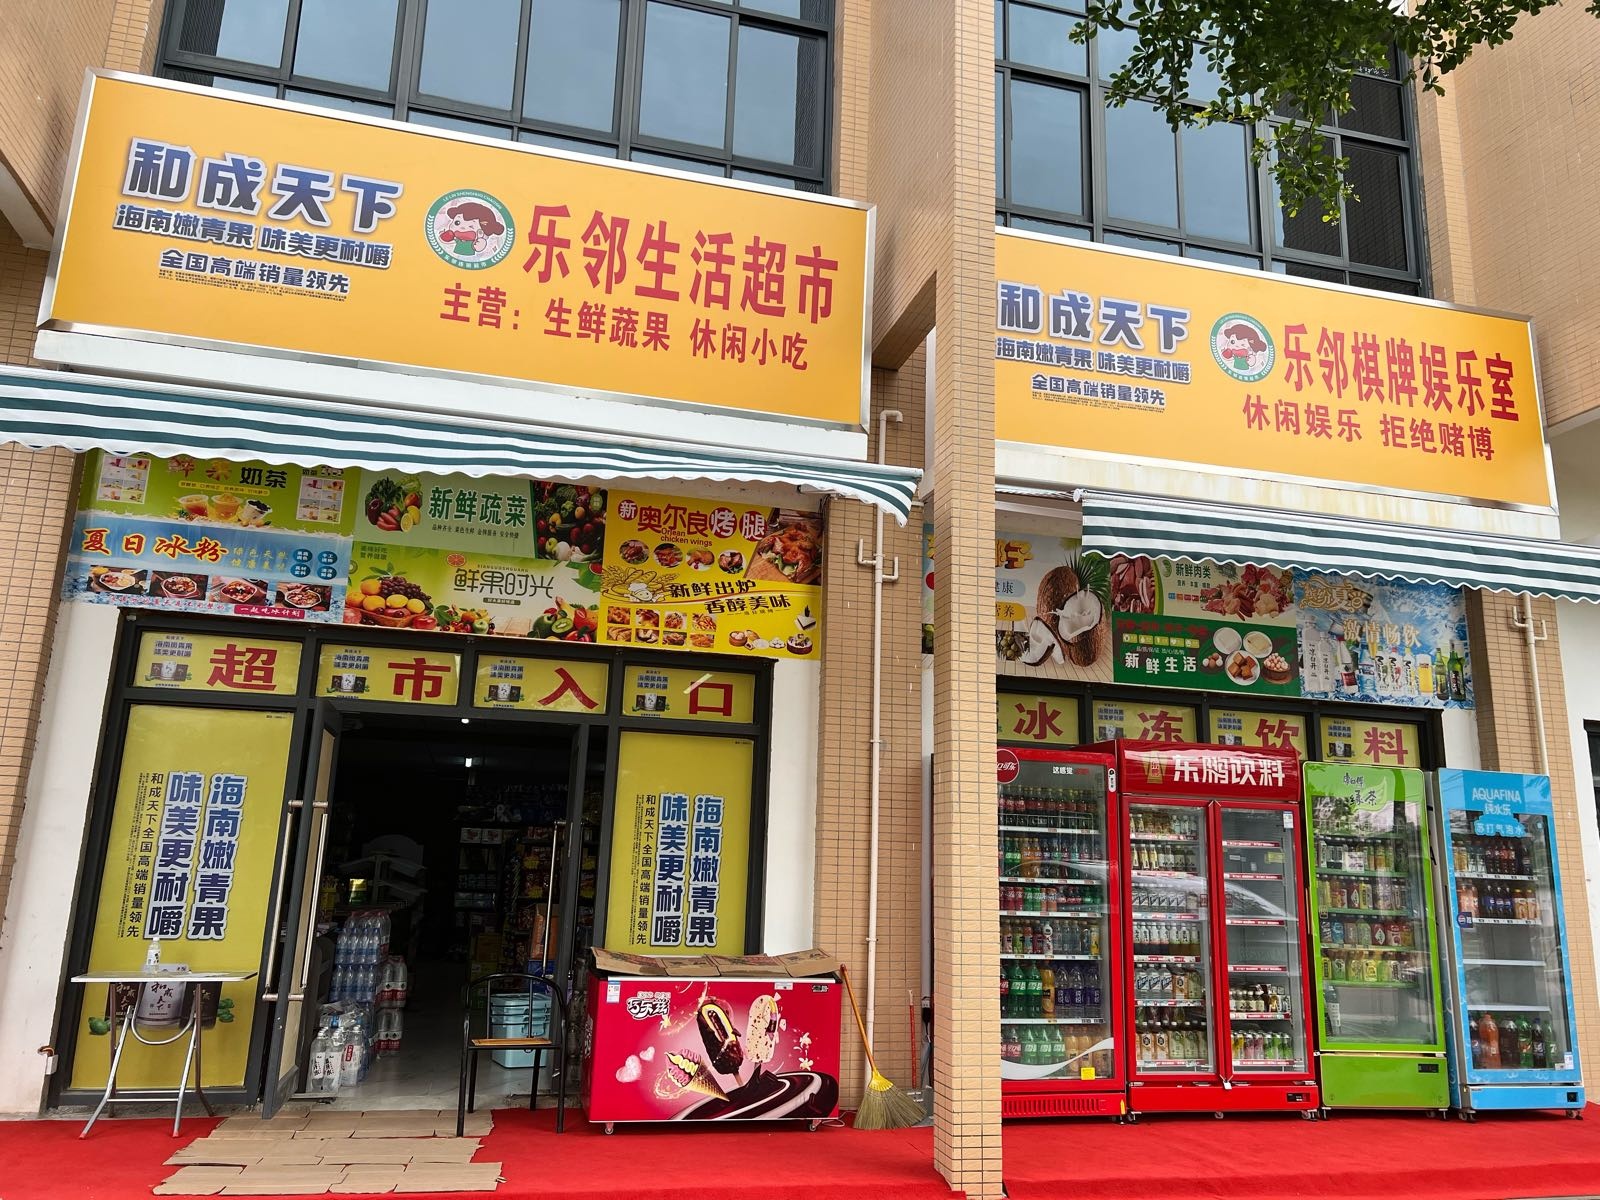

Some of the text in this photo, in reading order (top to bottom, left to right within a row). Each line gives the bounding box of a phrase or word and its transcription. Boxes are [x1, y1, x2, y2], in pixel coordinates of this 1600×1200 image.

[124, 137, 403, 233] 和成天下
[113, 205, 393, 269] 海南嫩青果 味美更耐嚼
[159, 249, 350, 294] 全国高端销量领先
[523, 205, 839, 325] 乐邻生活超市
[544, 297, 671, 352] 生鲜蔬果
[690, 318, 808, 371] 休闲小吃
[996, 280, 1192, 353] 和成天下
[995, 337, 1192, 384] 海南嫩青果 味美更耐嚼
[1282, 324, 1520, 422] 乐邻棋牌娱乐室
[1031, 373, 1166, 406] 全国高端销量领先
[1243, 394, 1495, 462] 休闲娱乐 拒绝赌博
[82, 527, 229, 563] 夏日冰粉
[660, 535, 713, 548] chicken wings
[453, 567, 555, 599] 鲜果时光
[668, 579, 757, 599] 新鲜出炉
[1175, 562, 1211, 579] 新鲜肉类
[704, 593, 792, 615] 香醇美味
[1343, 618, 1422, 648] 激情畅饮
[206, 643, 733, 717] 超 市 入 口
[1124, 652, 1197, 675] 新鲜生活
[1013, 701, 1064, 739] 冰
[1137, 710, 1185, 743] 冻
[1255, 718, 1302, 755] 饮
[1363, 726, 1408, 766] 料
[996, 761, 1017, 772] 口可乐
[1173, 755, 1286, 787] 东鹏饮料
[1472, 787, 1522, 804] AQUAFINA
[127, 772, 164, 938] 和成天下全国高端销量领先
[144, 771, 204, 940] 味美更耐嚼
[187, 773, 247, 941] 海南嫩青果
[1474, 823, 1522, 836] 苏打气泡水
[636, 794, 656, 945] 和成天下全国高端销量领先
[650, 792, 690, 947] 味美更耐嚼
[685, 793, 725, 947] 海南嫩青果
